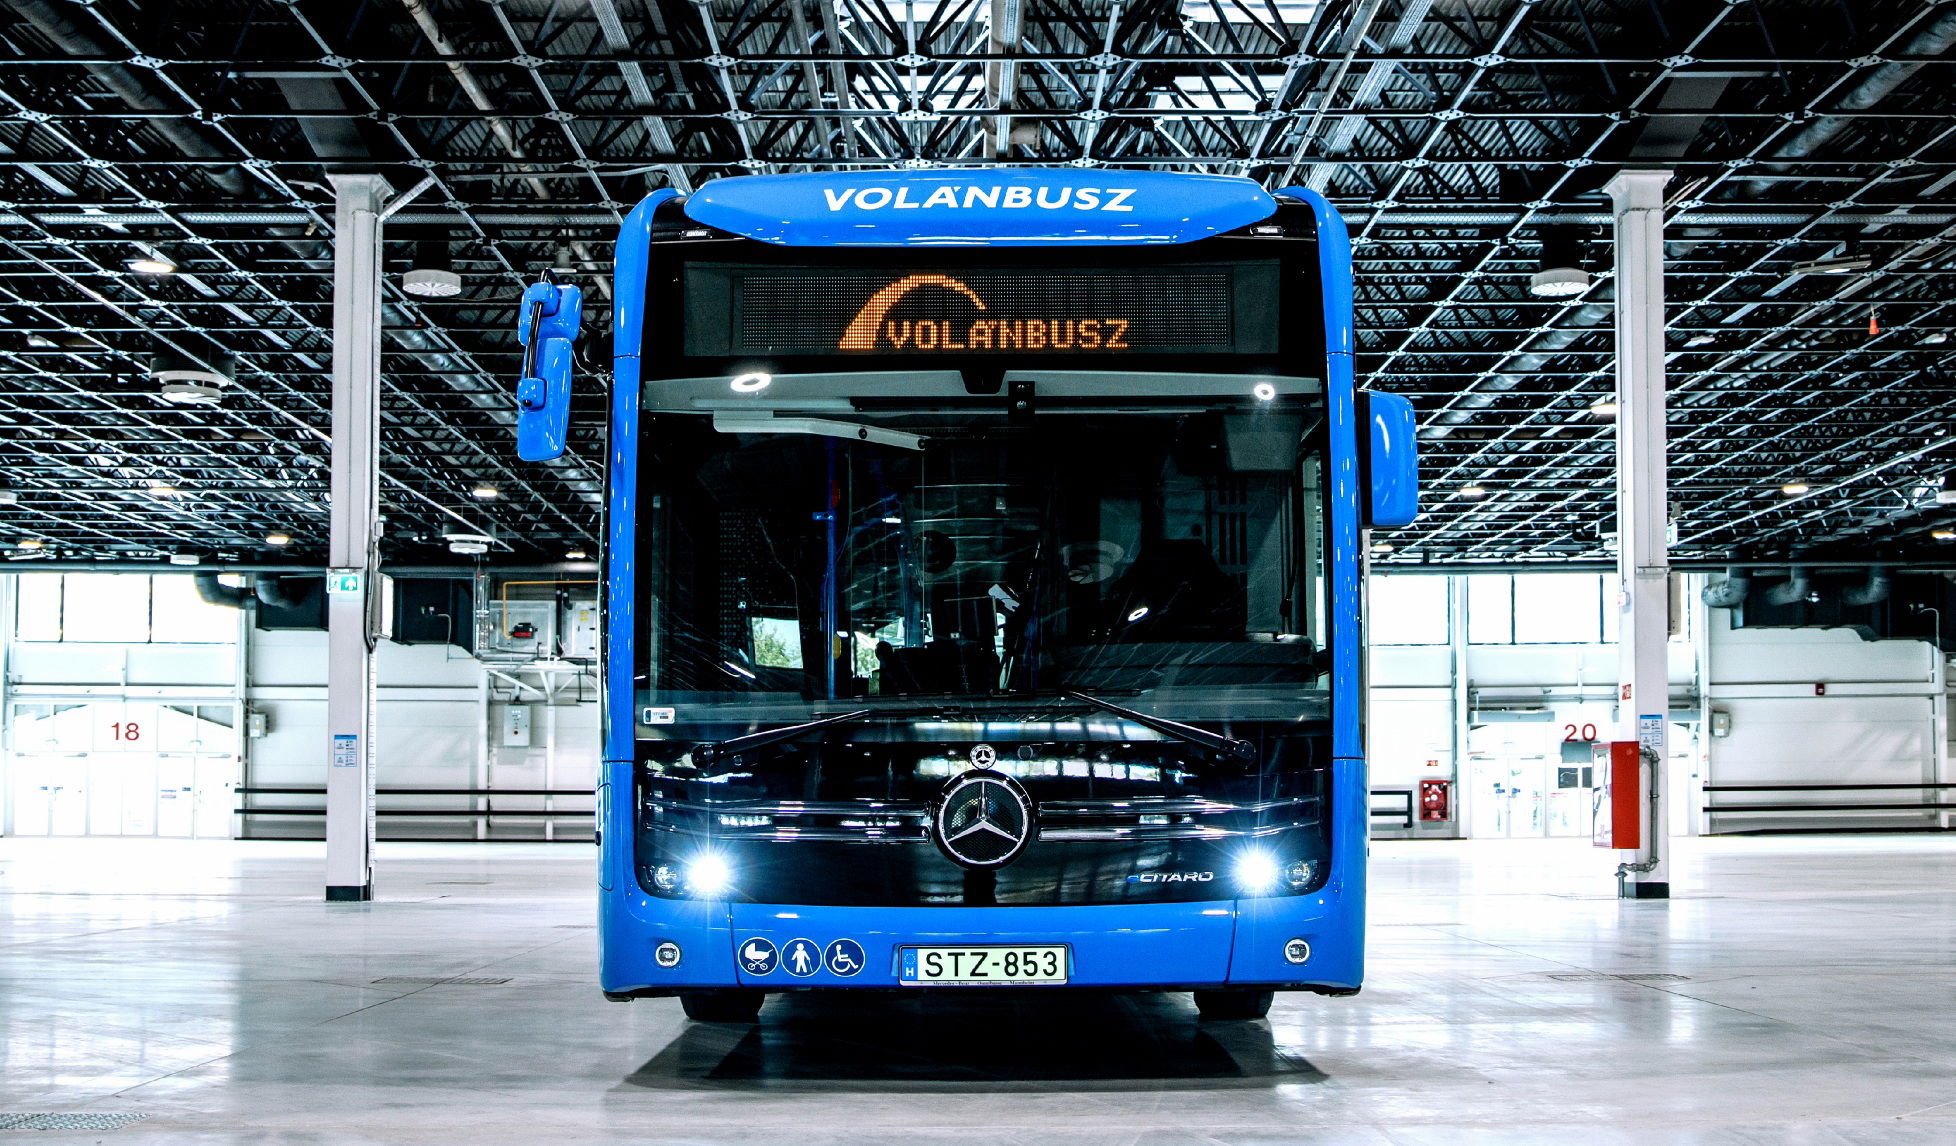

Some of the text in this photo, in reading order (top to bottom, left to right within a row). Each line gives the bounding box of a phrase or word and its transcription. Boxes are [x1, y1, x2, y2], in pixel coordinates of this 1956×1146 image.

[823, 186, 1137, 212] VOLÁNBUSZ
[887, 320, 1128, 349] VOLÁNBUSZ
[111, 722, 139, 741] 18
[1564, 723, 1597, 742] 20
[905, 967, 915, 977] H
[925, 951, 1058, 977] STZ-853
